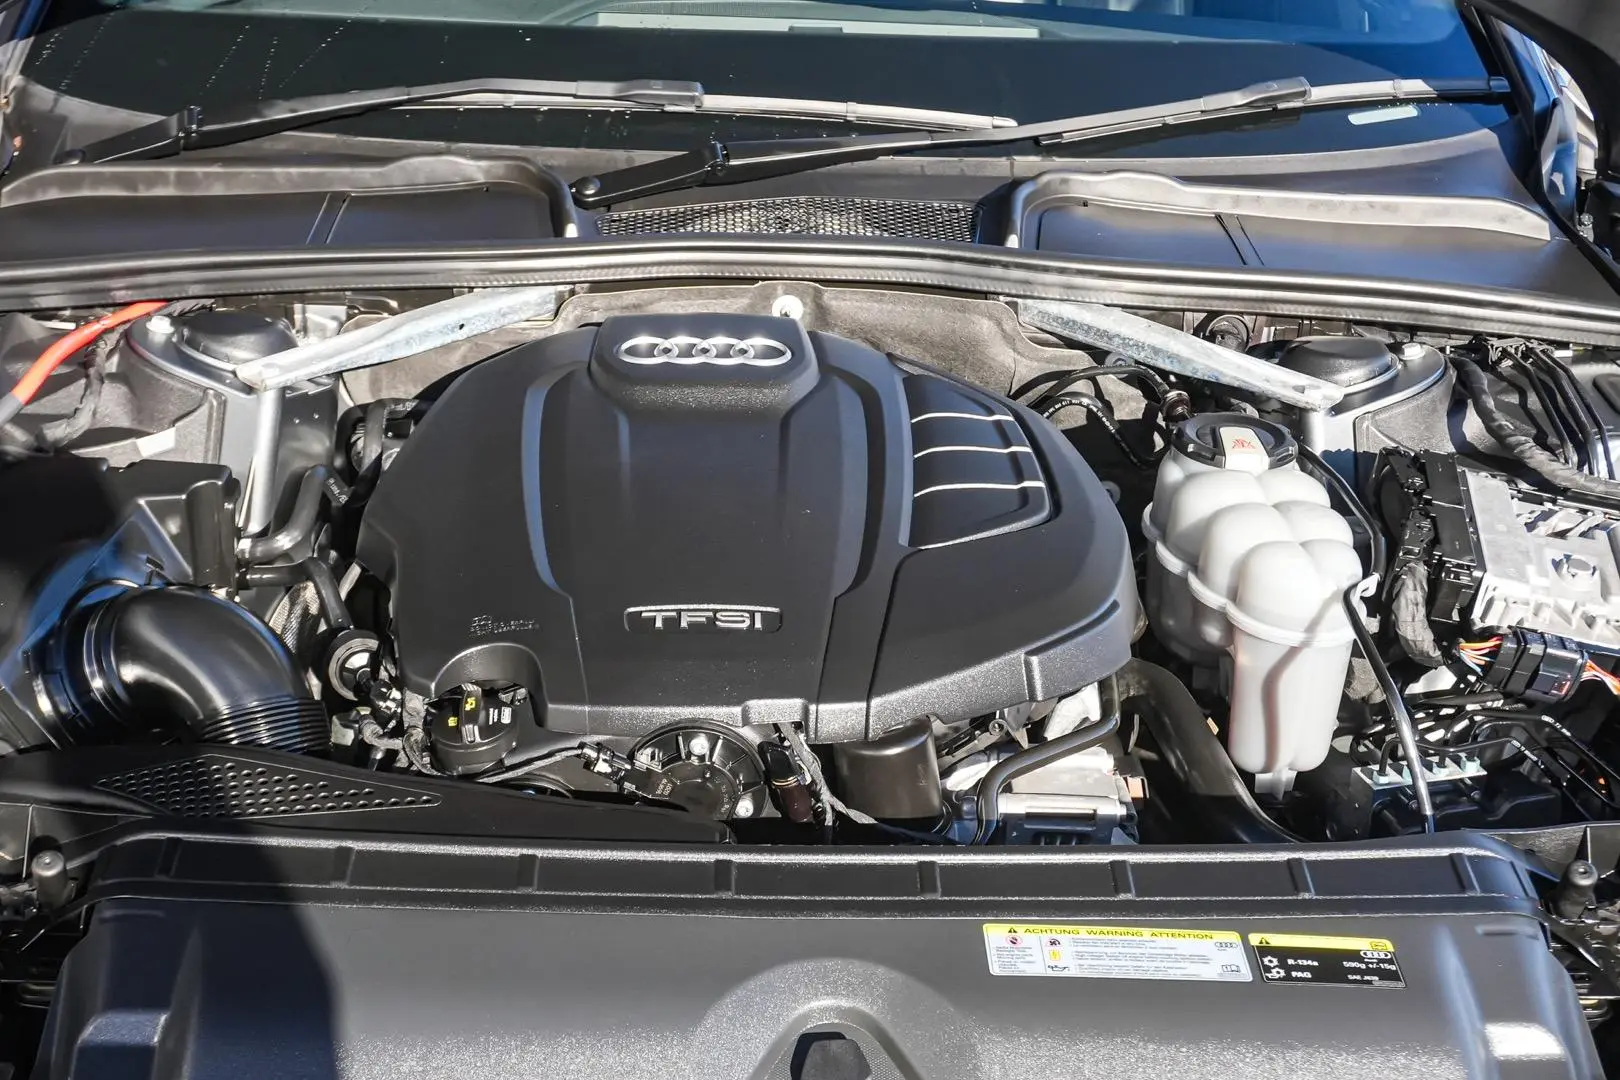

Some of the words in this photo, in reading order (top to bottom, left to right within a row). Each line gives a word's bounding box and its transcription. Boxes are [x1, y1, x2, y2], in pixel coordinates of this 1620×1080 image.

[641, 611, 762, 631] TFSI
[1023, 927, 1080, 936] ACHTUNG
[1086, 929, 1143, 938] WARNING
[1150, 931, 1214, 940] ATTENTION
[1286, 958, 1319, 967] R-134a
[1291, 971, 1312, 979] PAG
